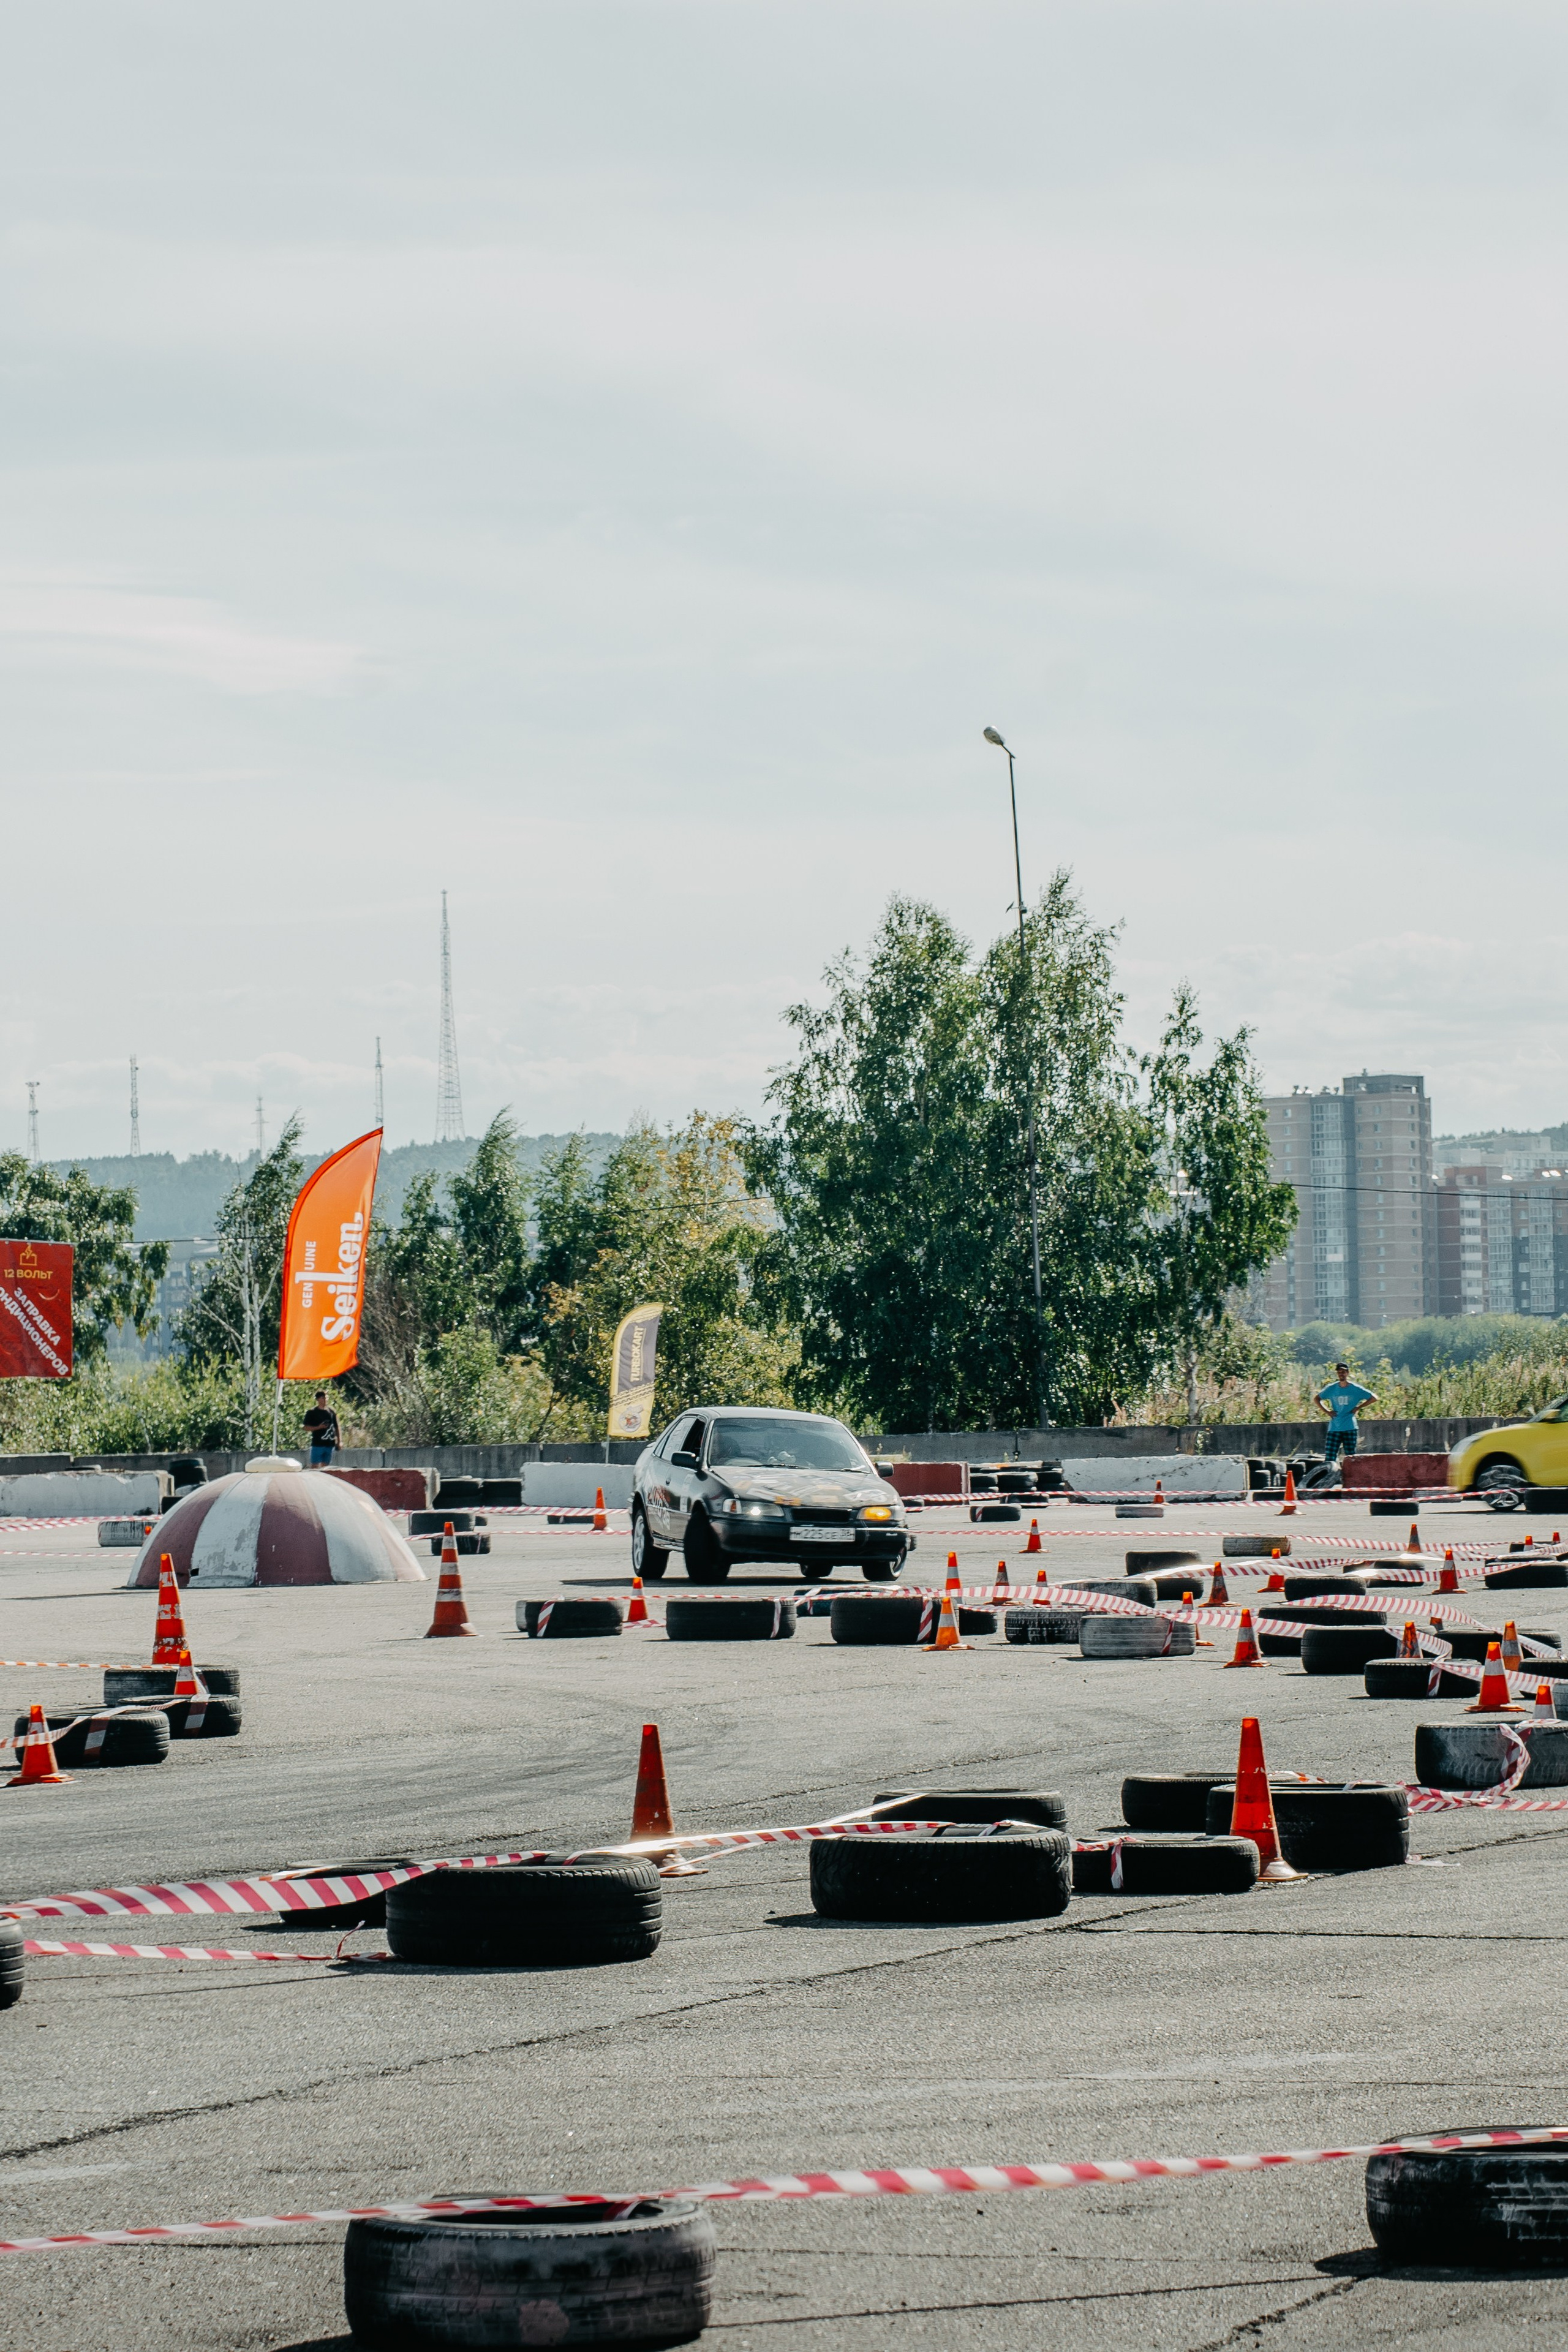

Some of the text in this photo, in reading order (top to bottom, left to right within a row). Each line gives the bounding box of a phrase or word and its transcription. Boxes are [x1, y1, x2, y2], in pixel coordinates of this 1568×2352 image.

[4, 1269, 53, 1280] 12 ВОЛЬТ
[295, 1212, 364, 1341] Seiken
[14, 1287, 61, 1346] ЗАПРАВКА
[631, 1325, 644, 1382] TURBOKART
